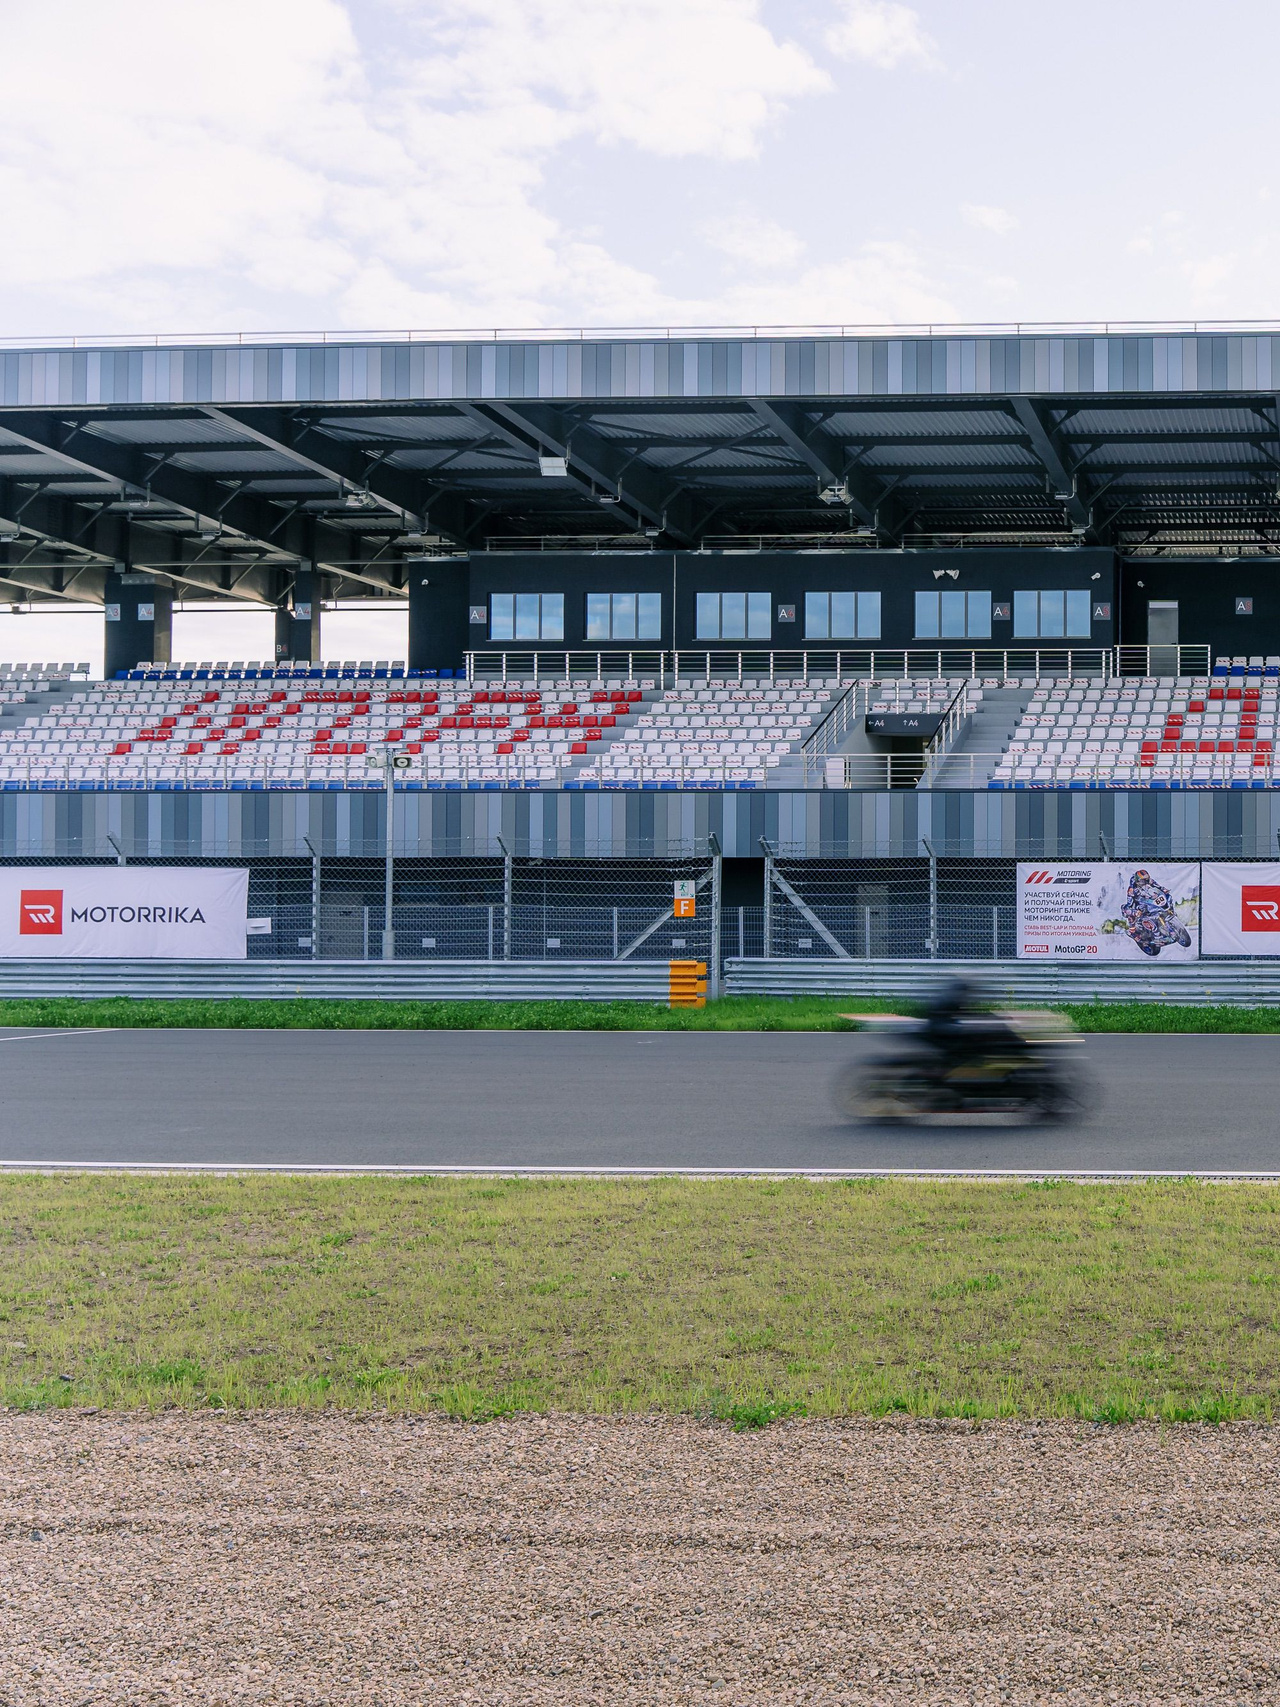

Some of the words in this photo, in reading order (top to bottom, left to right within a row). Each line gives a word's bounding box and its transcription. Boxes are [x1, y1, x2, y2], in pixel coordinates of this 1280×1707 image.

[106, 609, 119, 617] A3
[139, 608, 153, 617] A4
[296, 604, 310, 615] A4
[470, 610, 486, 620] A4
[779, 608, 794, 619] A4
[993, 606, 1009, 617] A4
[680, 900, 690, 915] F
[1066, 899, 1093, 907] ПРИЗЫ.
[71, 906, 206, 924] MOTORRIKA
